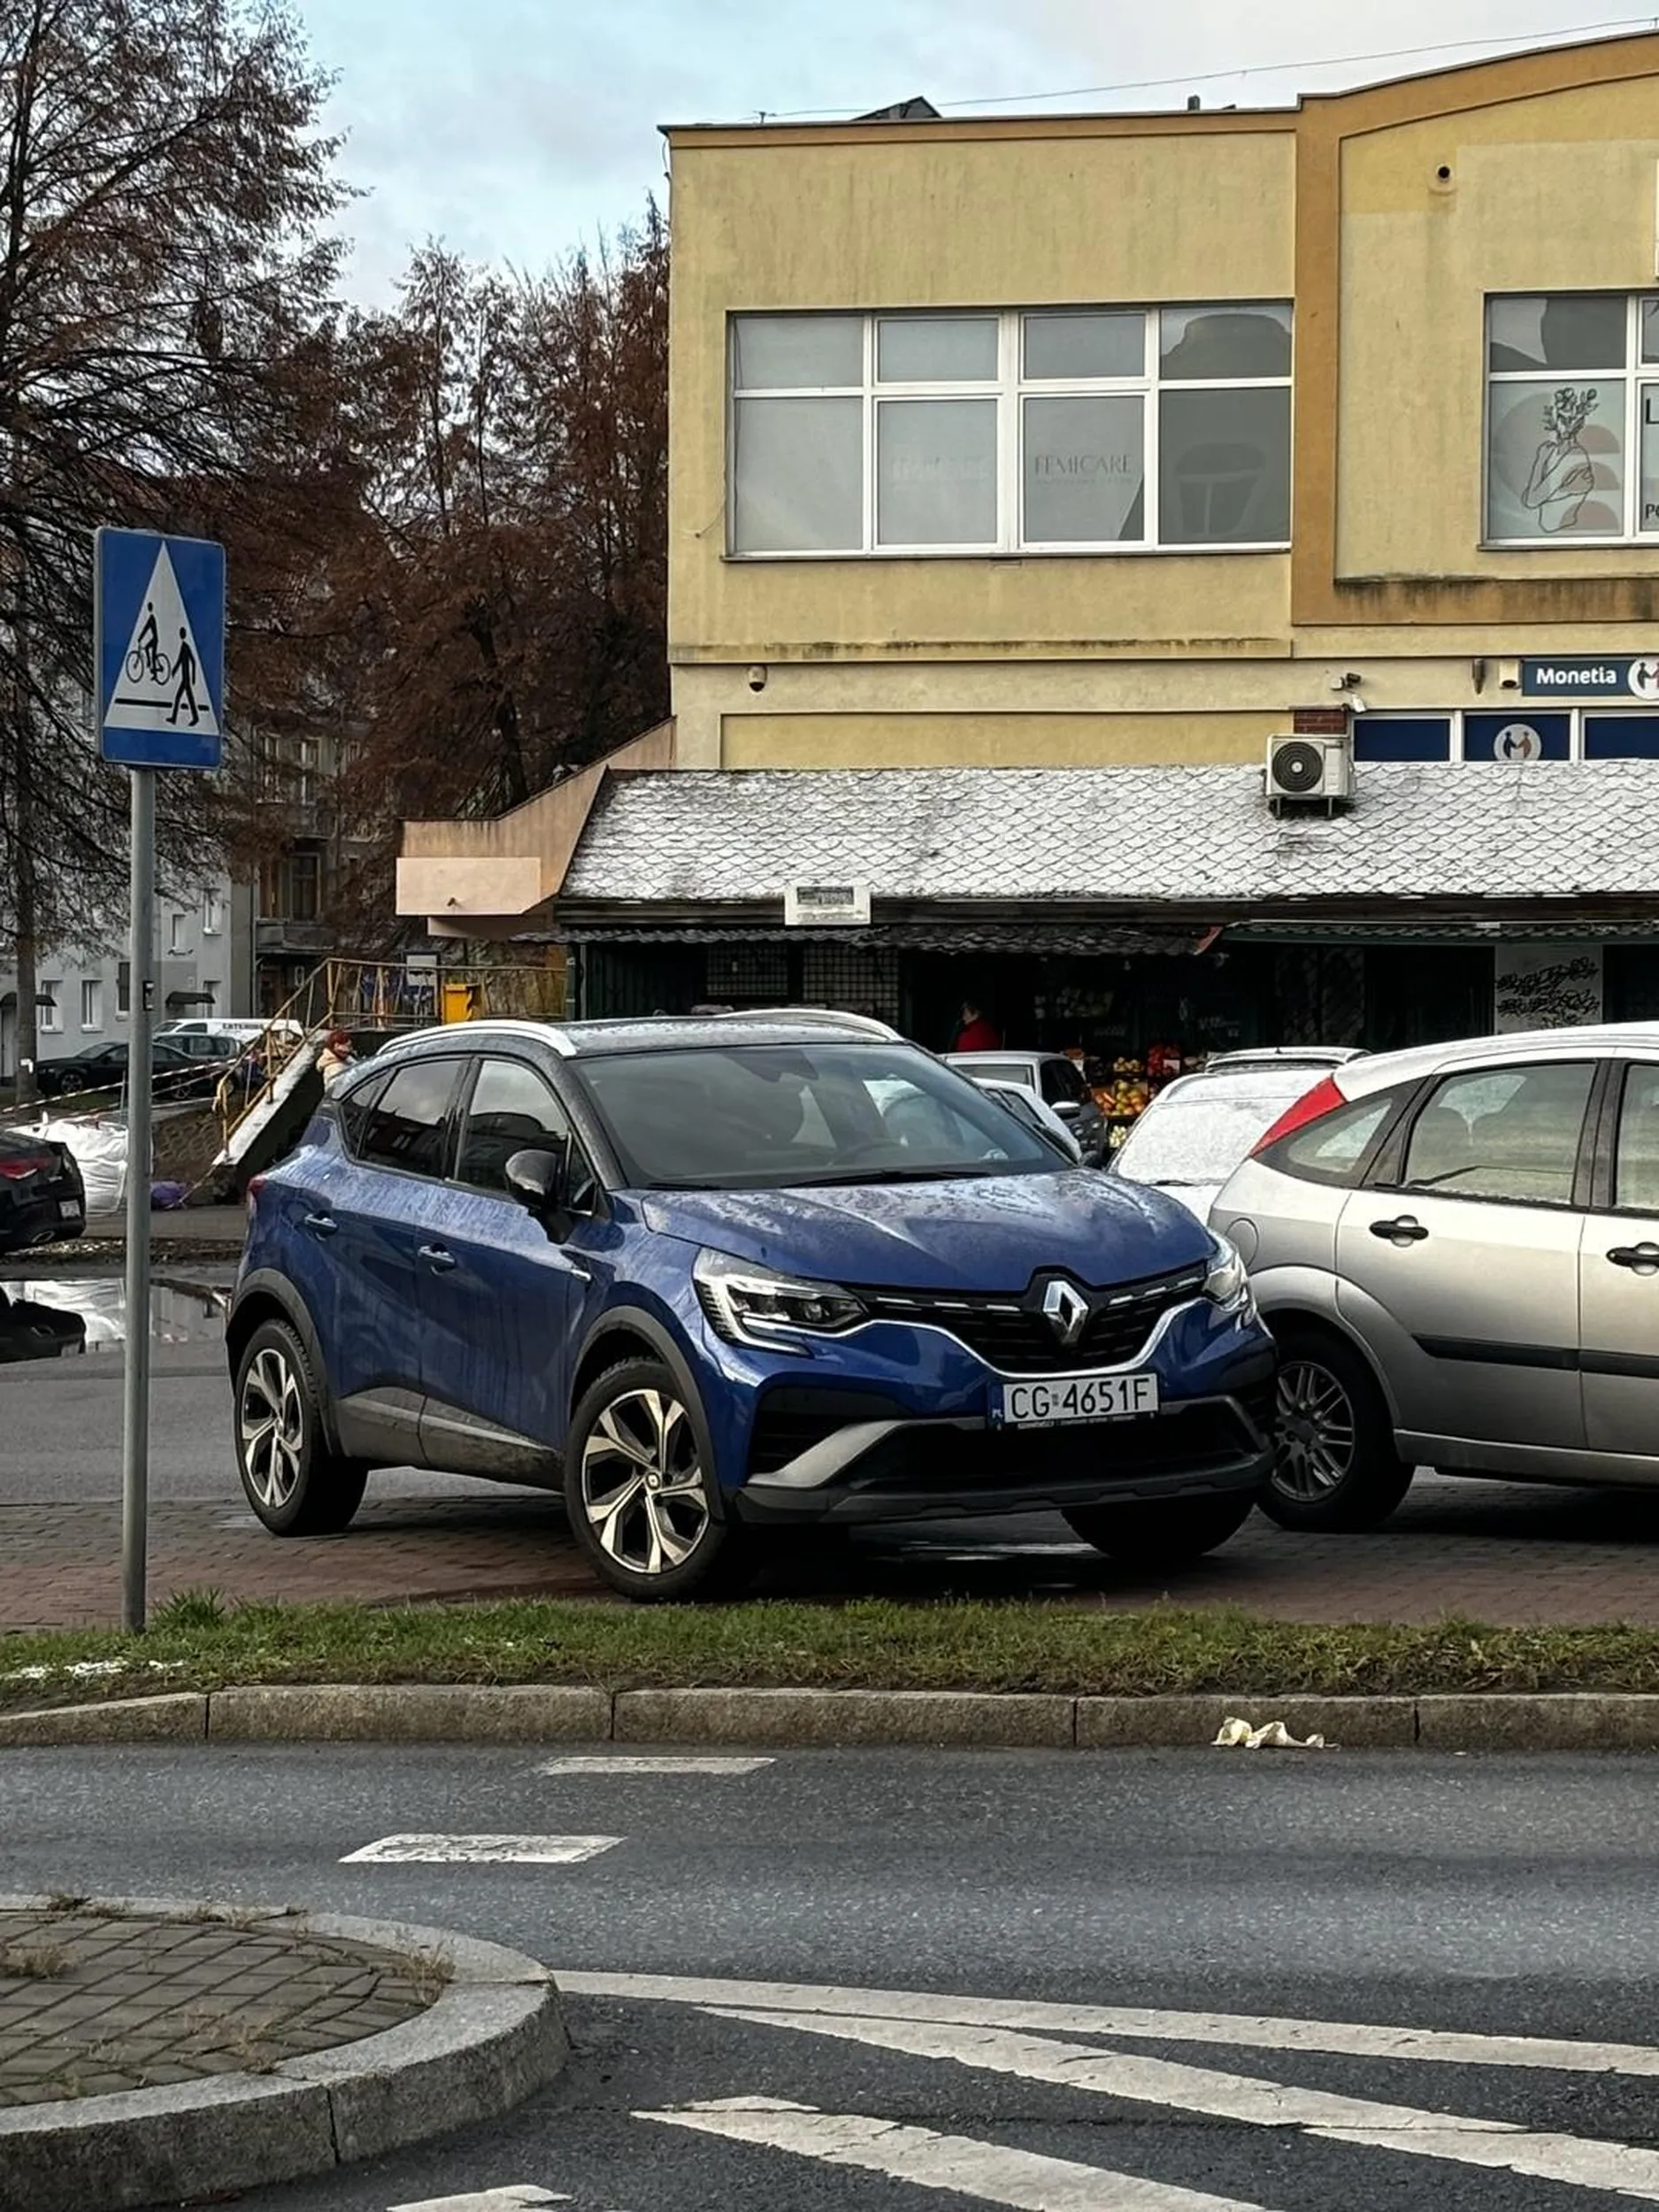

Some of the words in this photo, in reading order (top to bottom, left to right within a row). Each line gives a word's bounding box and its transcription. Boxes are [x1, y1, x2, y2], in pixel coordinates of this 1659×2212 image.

[1034, 454, 1132, 474] FEMICARE
[1536, 666, 1617, 685] Monetia
[1011, 1386, 1050, 1418] CG
[1063, 1378, 1149, 1415] 4651F
